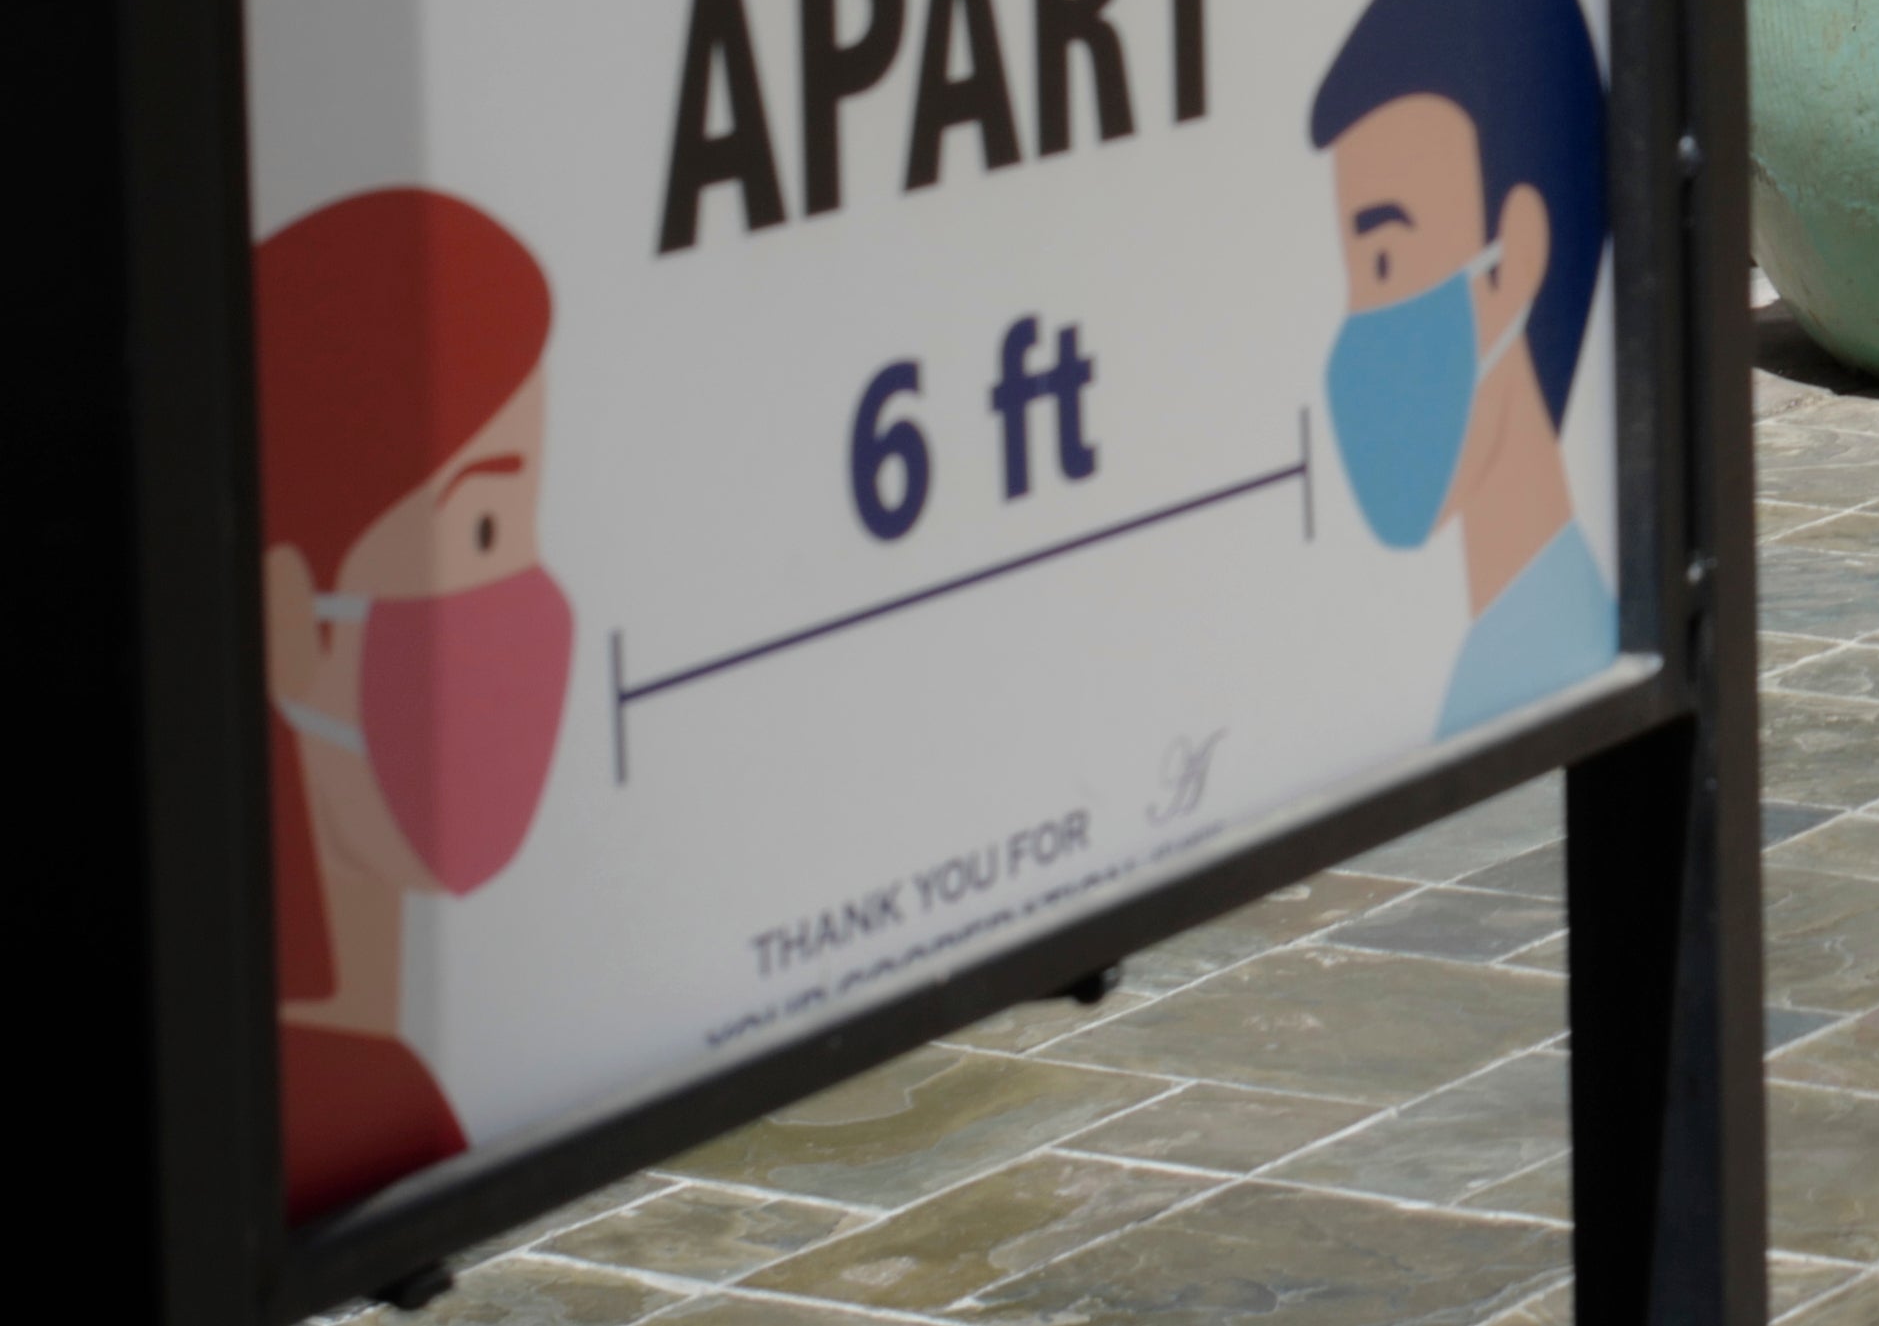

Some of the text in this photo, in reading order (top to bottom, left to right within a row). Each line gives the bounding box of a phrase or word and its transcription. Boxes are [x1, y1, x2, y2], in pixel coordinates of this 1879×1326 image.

[849, 316, 1097, 542] 6 ft
[750, 875, 902, 979] THANK
[911, 844, 1000, 909] YOU
[1005, 809, 1091, 878] FOR
